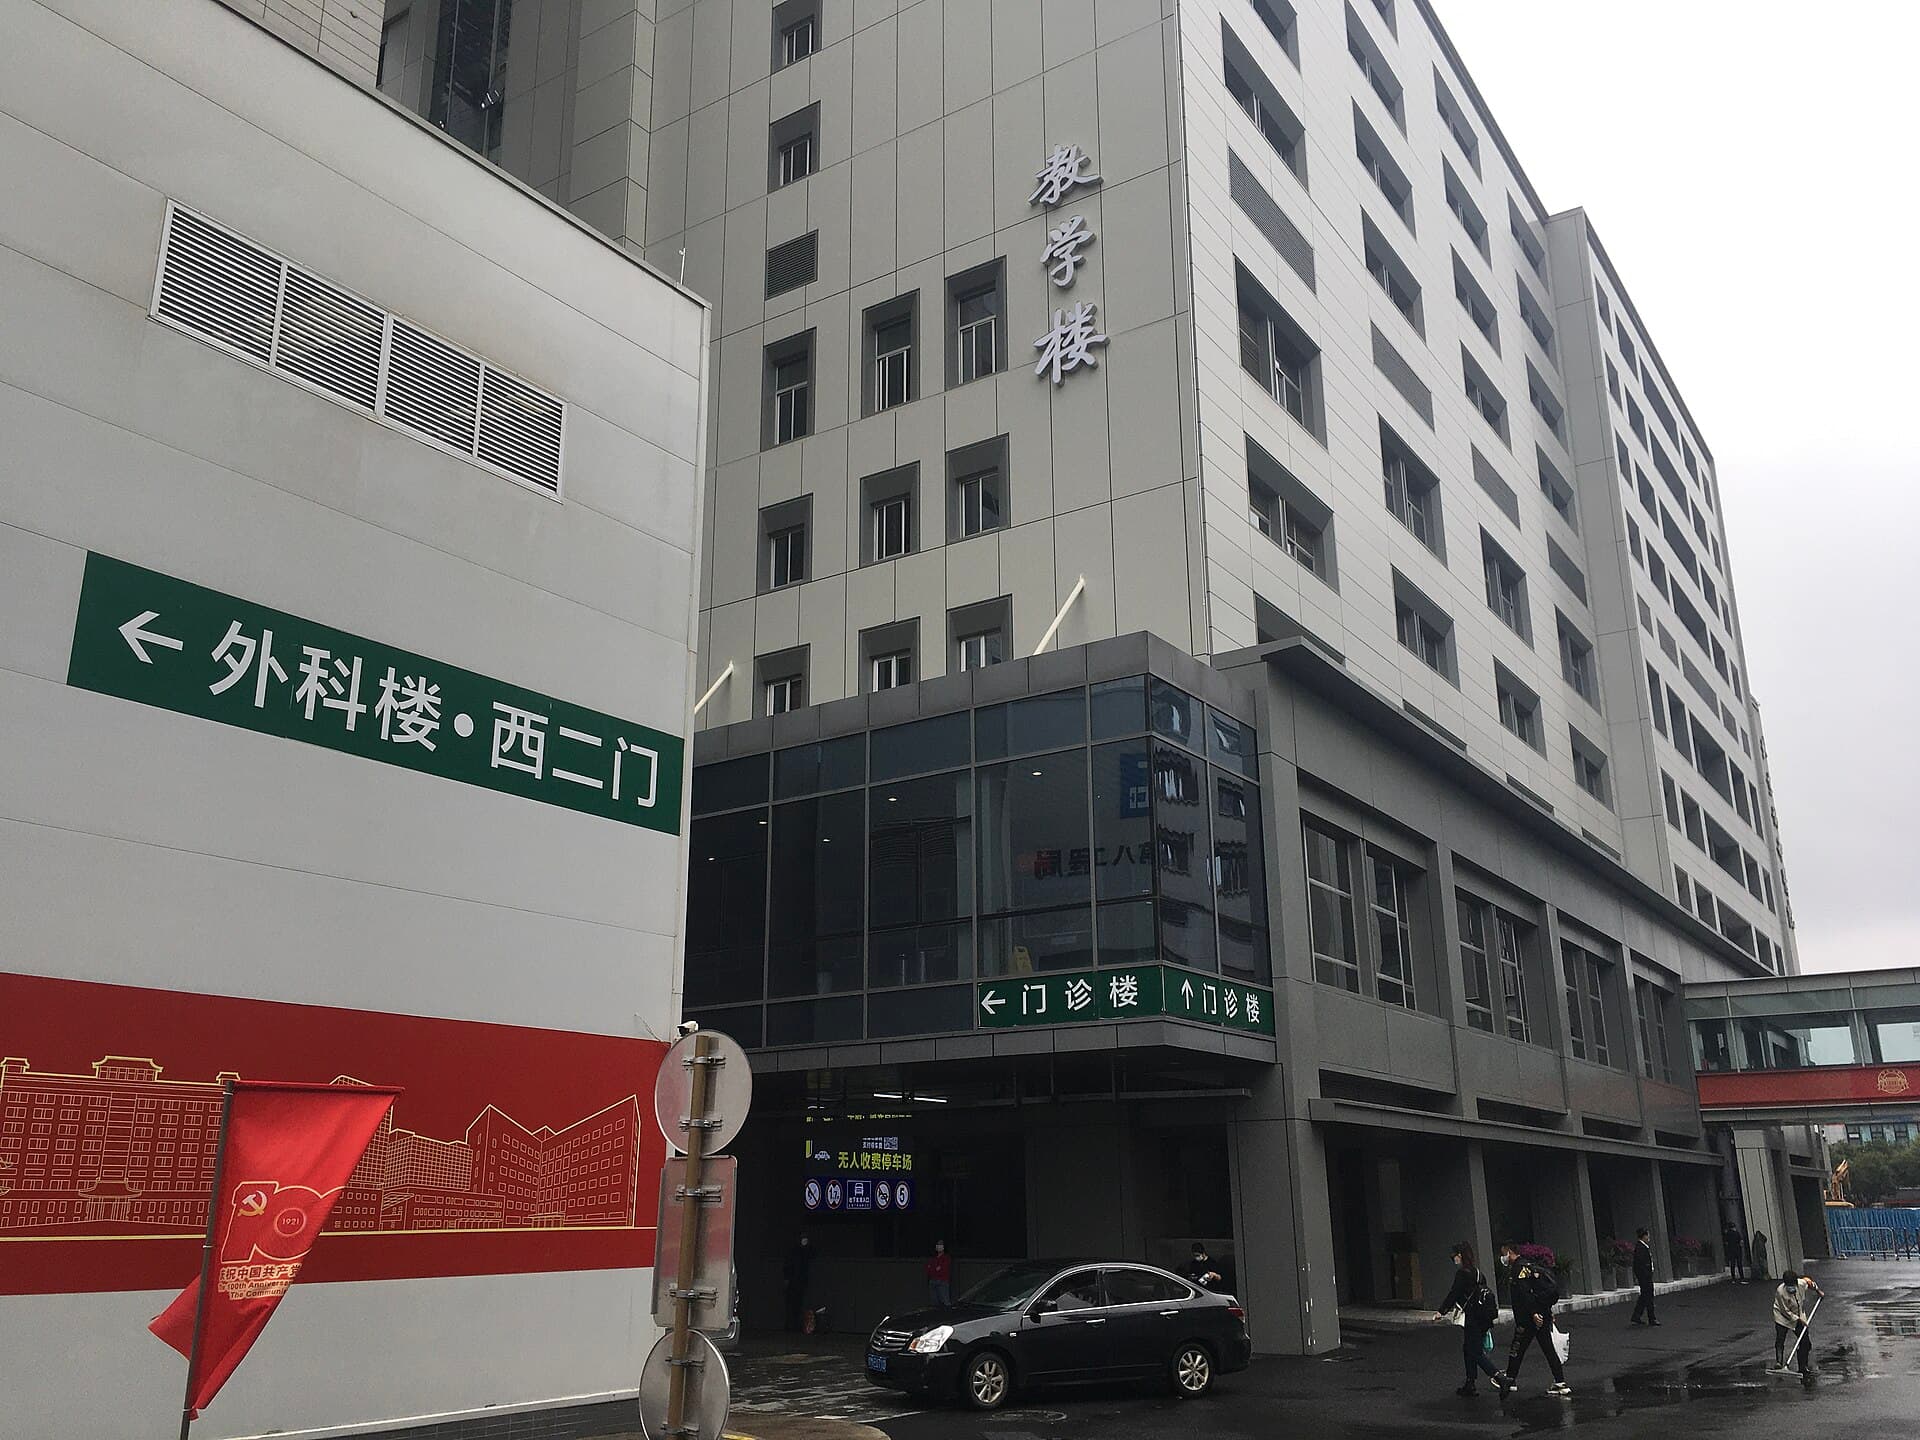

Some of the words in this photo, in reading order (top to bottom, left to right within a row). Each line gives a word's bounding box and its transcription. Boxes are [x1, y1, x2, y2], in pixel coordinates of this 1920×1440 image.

[1028, 143, 1109, 386] 教学楼
[1022, 975, 1138, 1014] 门诊楼
[1202, 982, 1260, 1024] 门诊楼
[838, 1151, 912, 1170] 无人收费停车场
[282, 1217, 301, 1226] 1921
